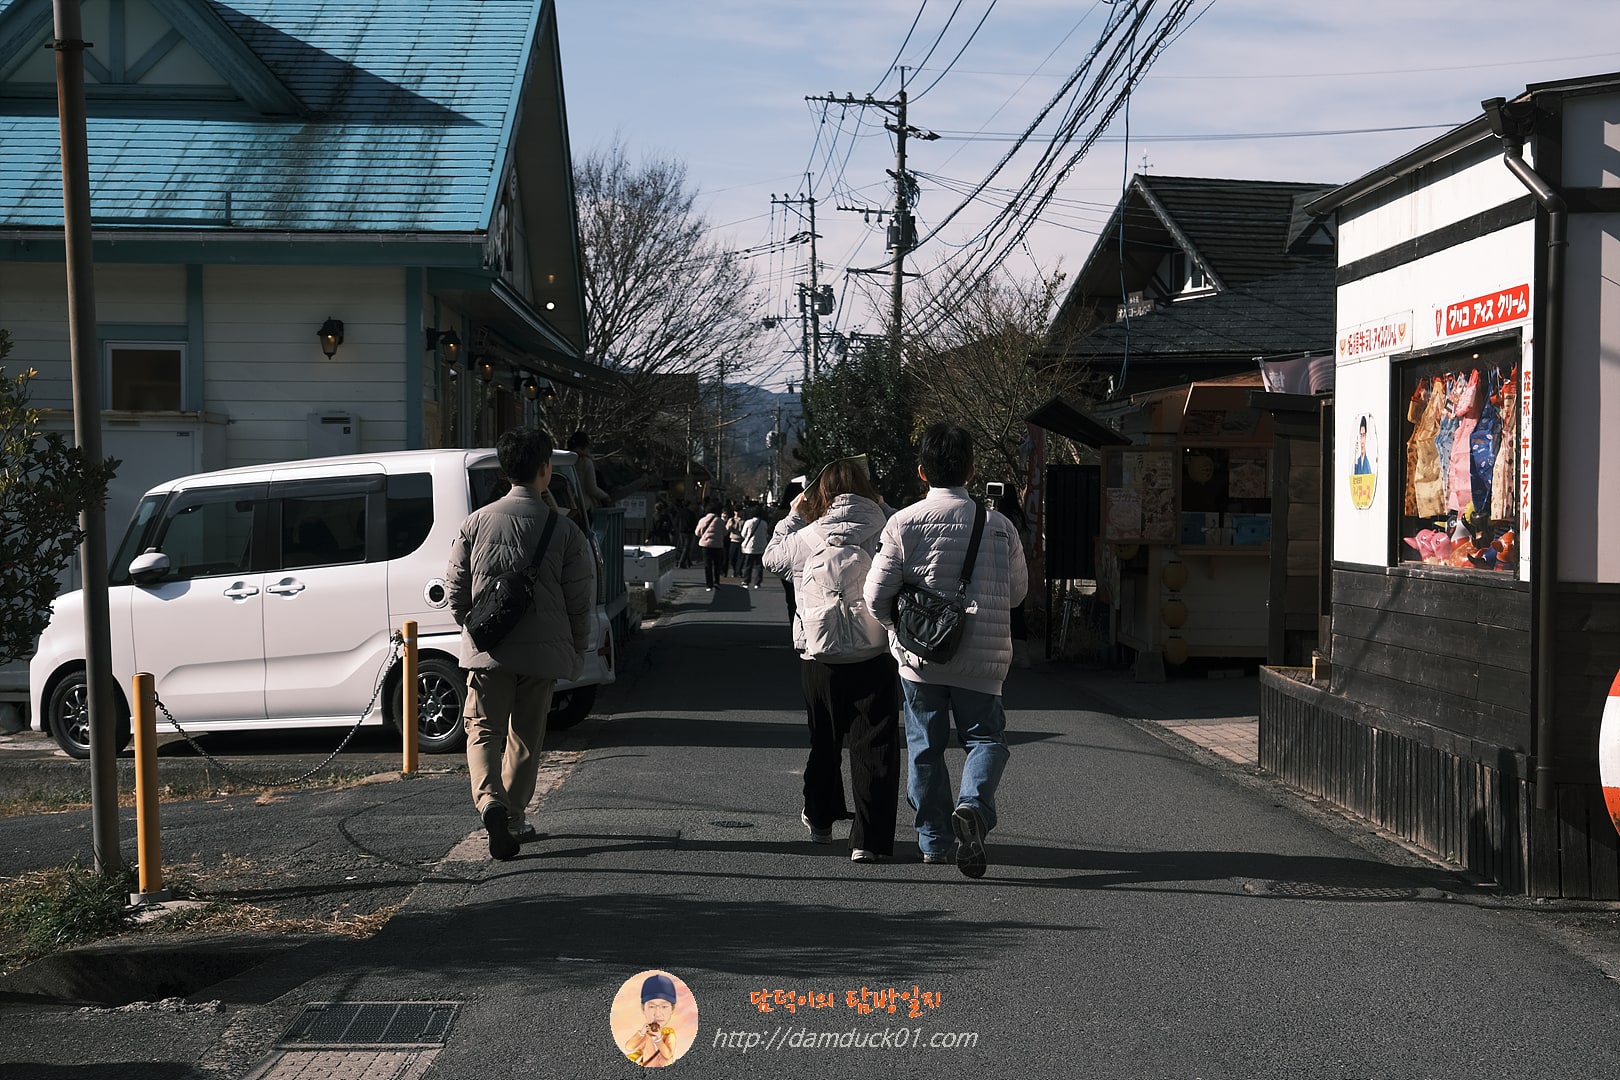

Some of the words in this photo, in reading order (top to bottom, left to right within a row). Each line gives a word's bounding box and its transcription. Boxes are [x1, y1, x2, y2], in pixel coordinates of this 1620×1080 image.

[1448, 305, 1470, 330] グリコ
[1473, 299, 1494, 325] アイス
[1497, 290, 1527, 319] クリーム
